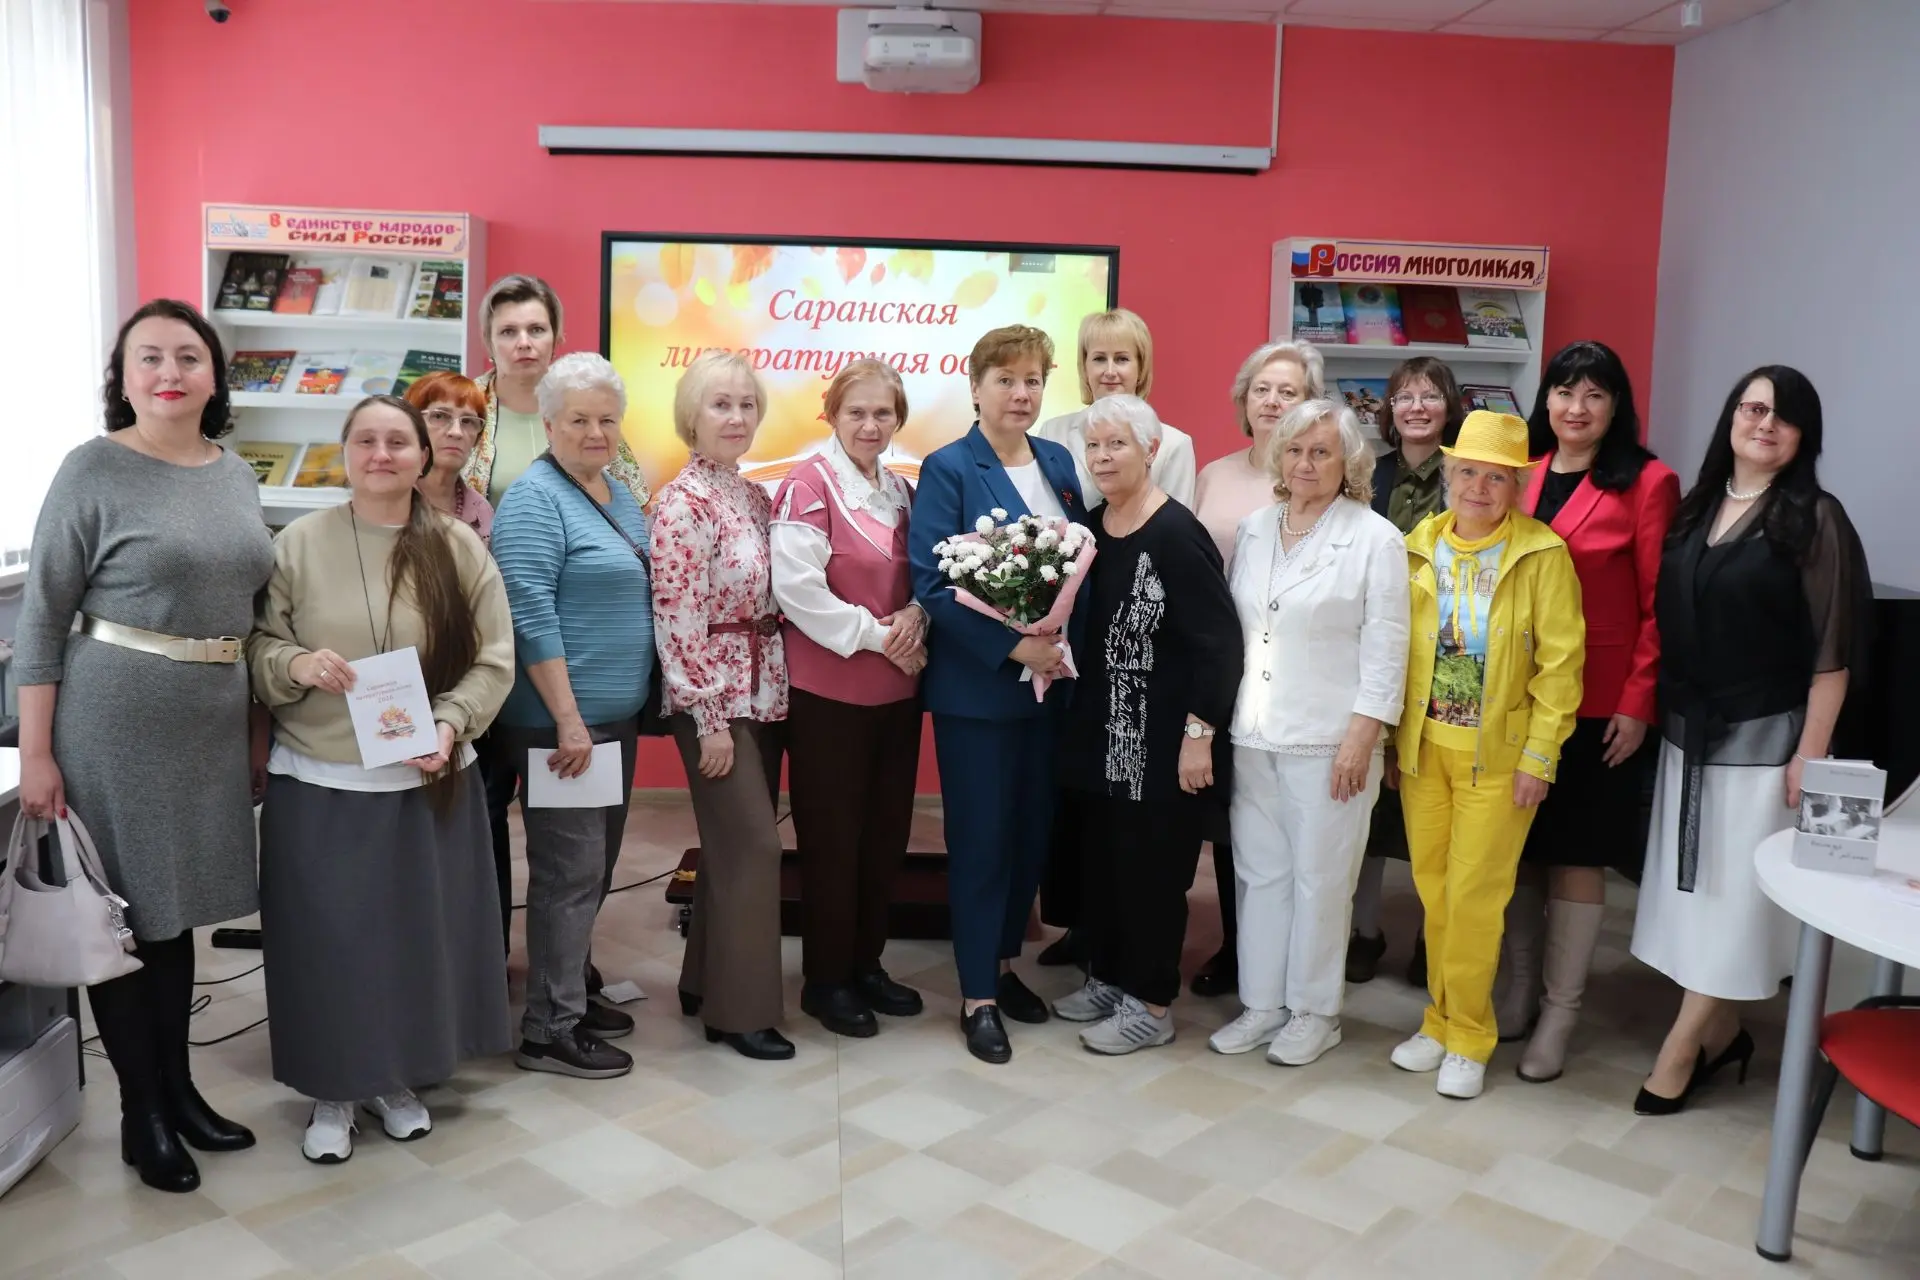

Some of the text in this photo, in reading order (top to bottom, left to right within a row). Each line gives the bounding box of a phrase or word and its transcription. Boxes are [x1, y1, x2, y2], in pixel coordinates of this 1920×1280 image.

[269, 213, 281, 227] В
[1308, 243, 1535, 280] РОССИЯ МНОГОЛИКАЯ
[768, 288, 958, 330] Саранская
